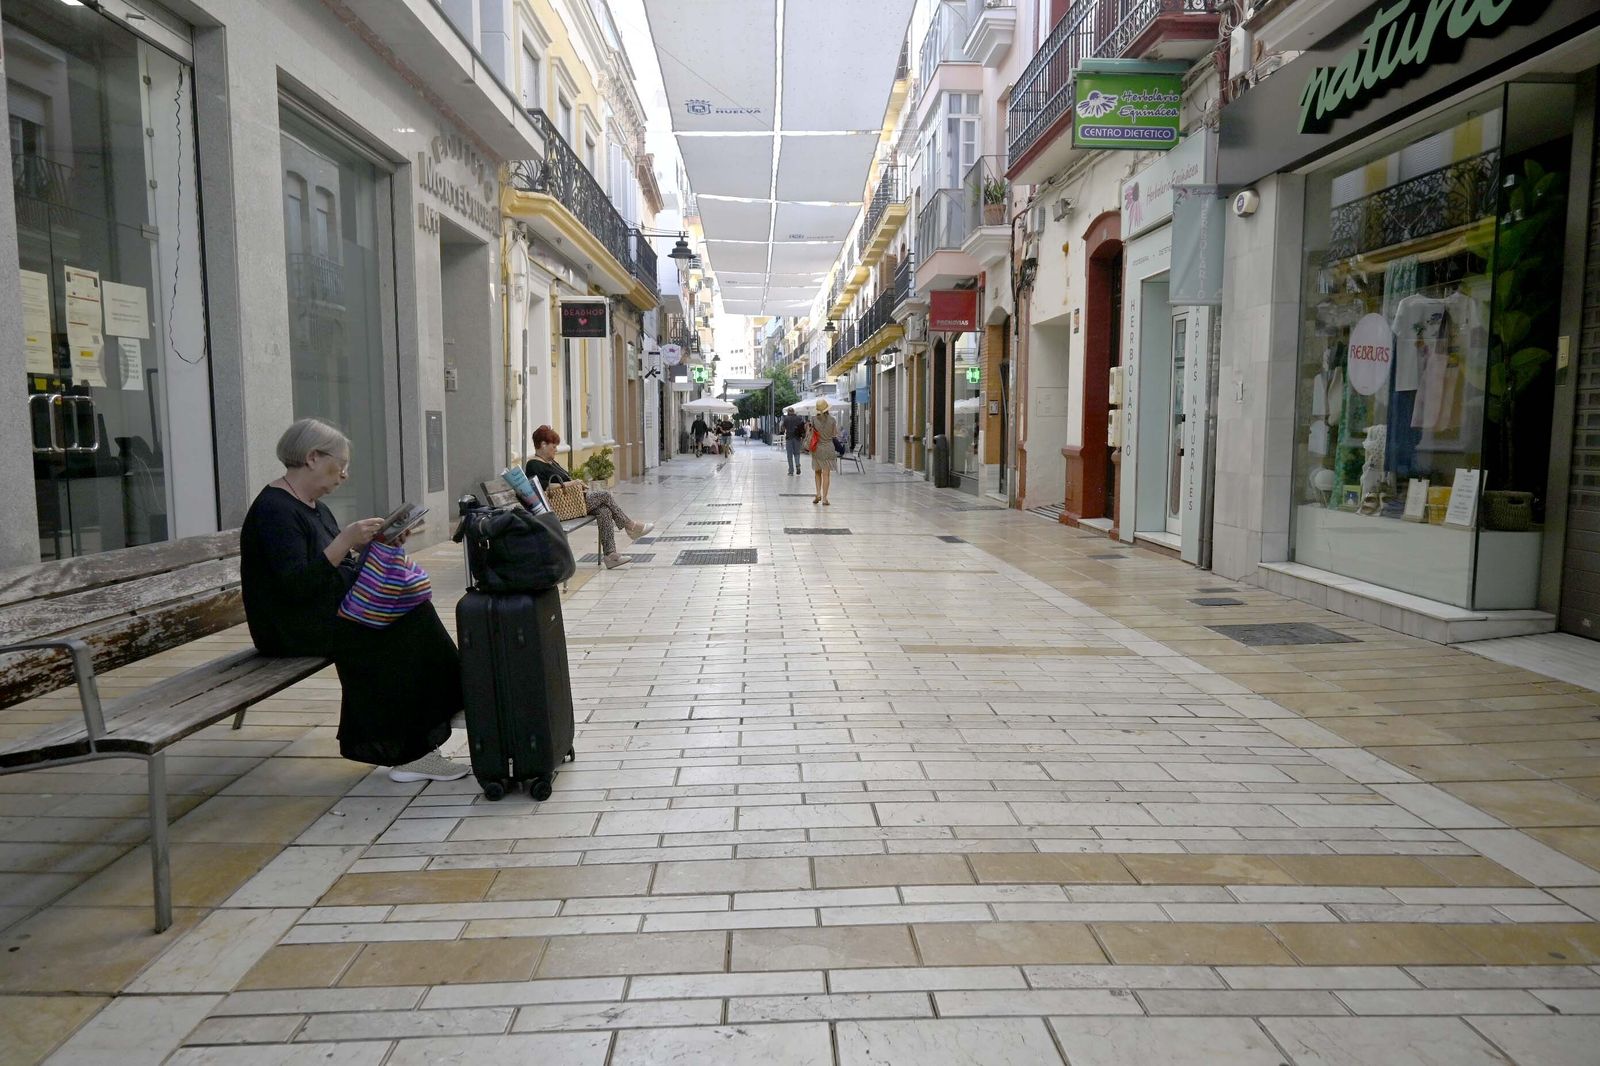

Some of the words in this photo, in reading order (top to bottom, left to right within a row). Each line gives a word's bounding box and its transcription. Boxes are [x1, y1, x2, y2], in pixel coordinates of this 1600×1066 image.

[1121, 88, 1180, 103] Herbolario
[1084, 127, 1122, 137] CENTRO
[1125, 300, 1136, 457] HERBOLARIO
[1187, 394, 1198, 511] NATURALES
